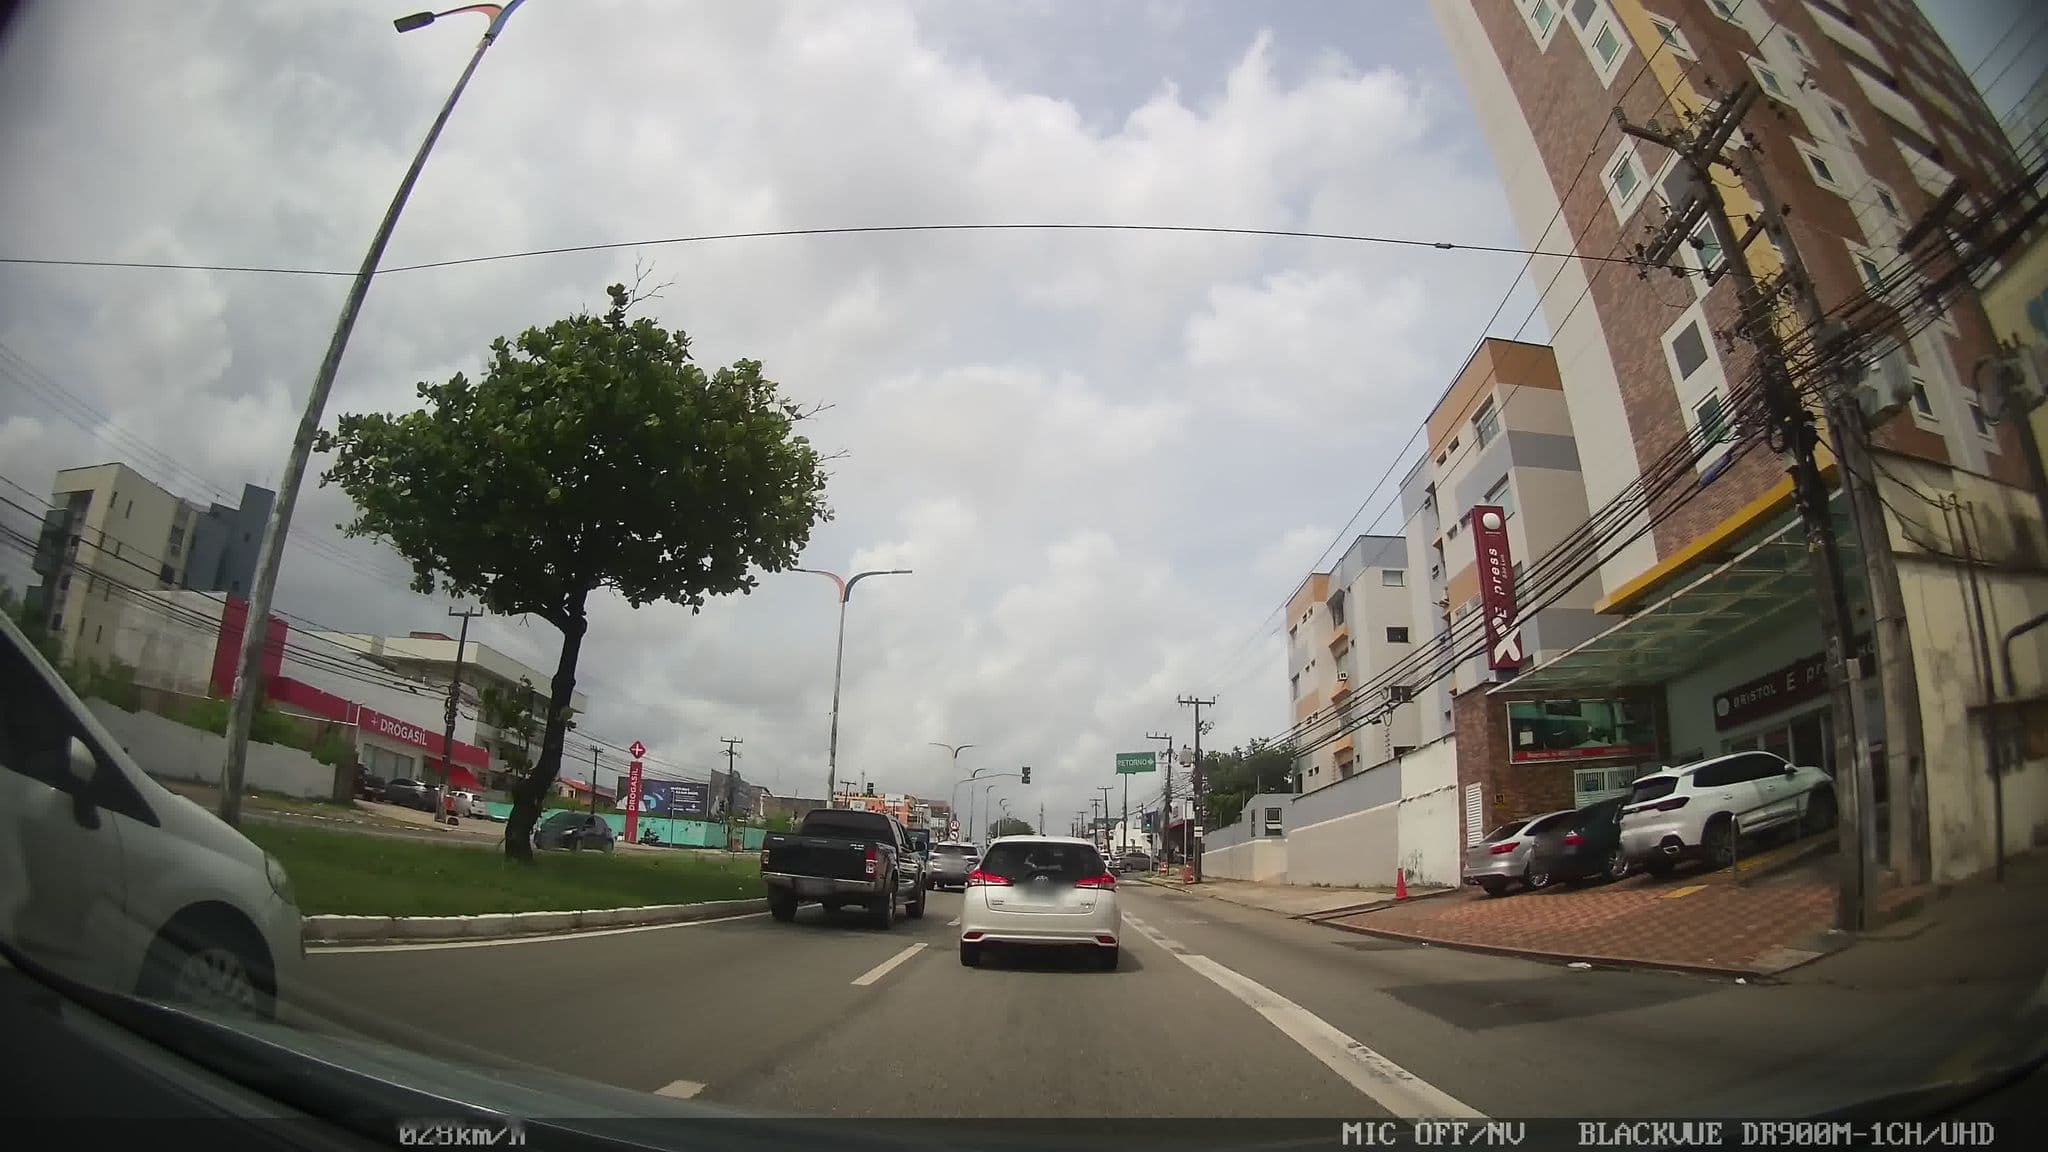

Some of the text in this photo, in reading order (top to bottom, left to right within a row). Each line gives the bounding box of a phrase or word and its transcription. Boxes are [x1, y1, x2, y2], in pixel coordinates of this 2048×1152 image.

[1488, 548, 1505, 596] press
[380, 718, 428, 746] DROGASIL
[628, 768, 639, 811] DROGASIL
